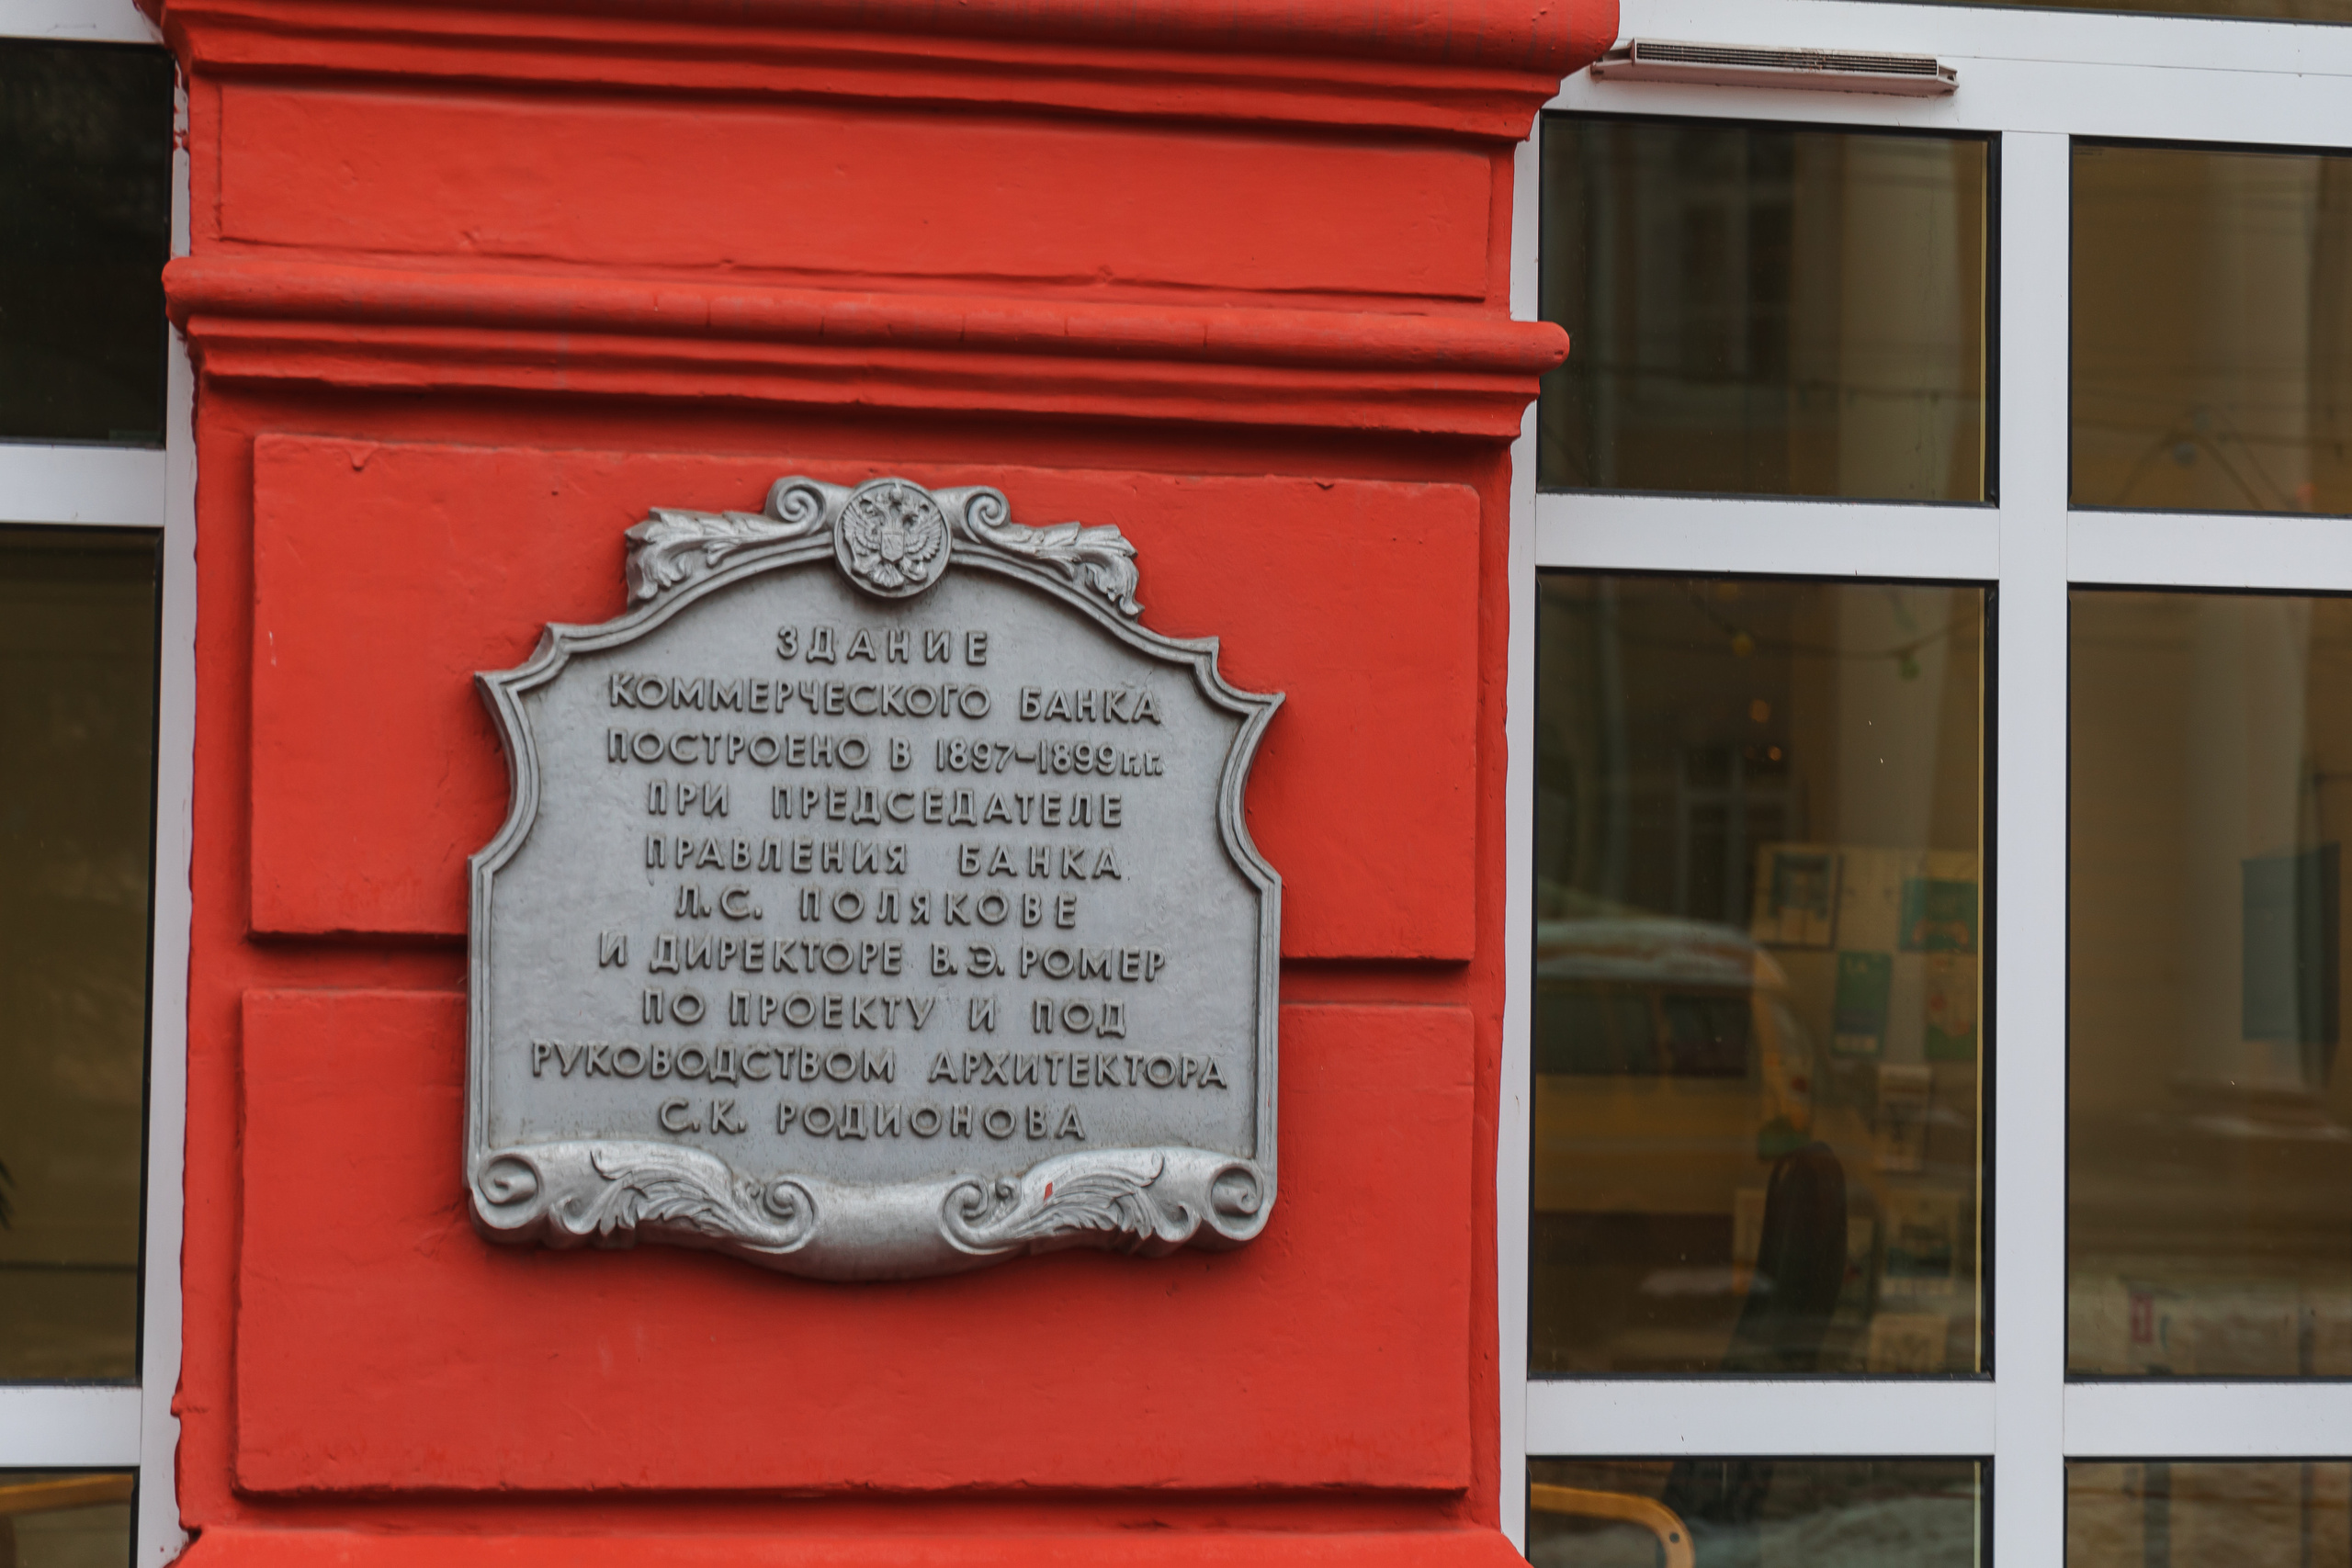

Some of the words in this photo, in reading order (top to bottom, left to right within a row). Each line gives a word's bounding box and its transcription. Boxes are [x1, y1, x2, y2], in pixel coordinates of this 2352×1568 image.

[776, 625, 989, 665] ЗДАНИЕ
[609, 671, 992, 718] КОММЕРЧЕСКОГО
[1020, 685, 1162, 724] БАНКА
[607, 728, 872, 768] ПОСТРОЕНО
[890, 737, 911, 771] В
[648, 780, 730, 816] ПРИ
[772, 784, 1123, 827] ПРЕДСЕДАТЕЛЕ
[645, 833, 908, 873] ПРАВЛЕНИЯ
[958, 840, 1123, 879] БАНКА
[675, 883, 763, 921] Л.С.
[799, 886, 1078, 930] ПОЛЯКОВЕ
[599, 931, 628, 967] И
[649, 933, 903, 975] ДИРЕКТОРЕ
[643, 987, 707, 1025] ПО
[730, 990, 935, 1031] ПРОЕКТУ
[969, 997, 996, 1032] И
[1033, 998, 1126, 1039] ПОД
[531, 1040, 896, 1084] РУКОВОДСТВОМ
[928, 1050, 1227, 1090] АРХИТЕКТОРА
[660, 1100, 747, 1135] С.К.
[776, 1101, 1086, 1141] РОДИОНОВА
